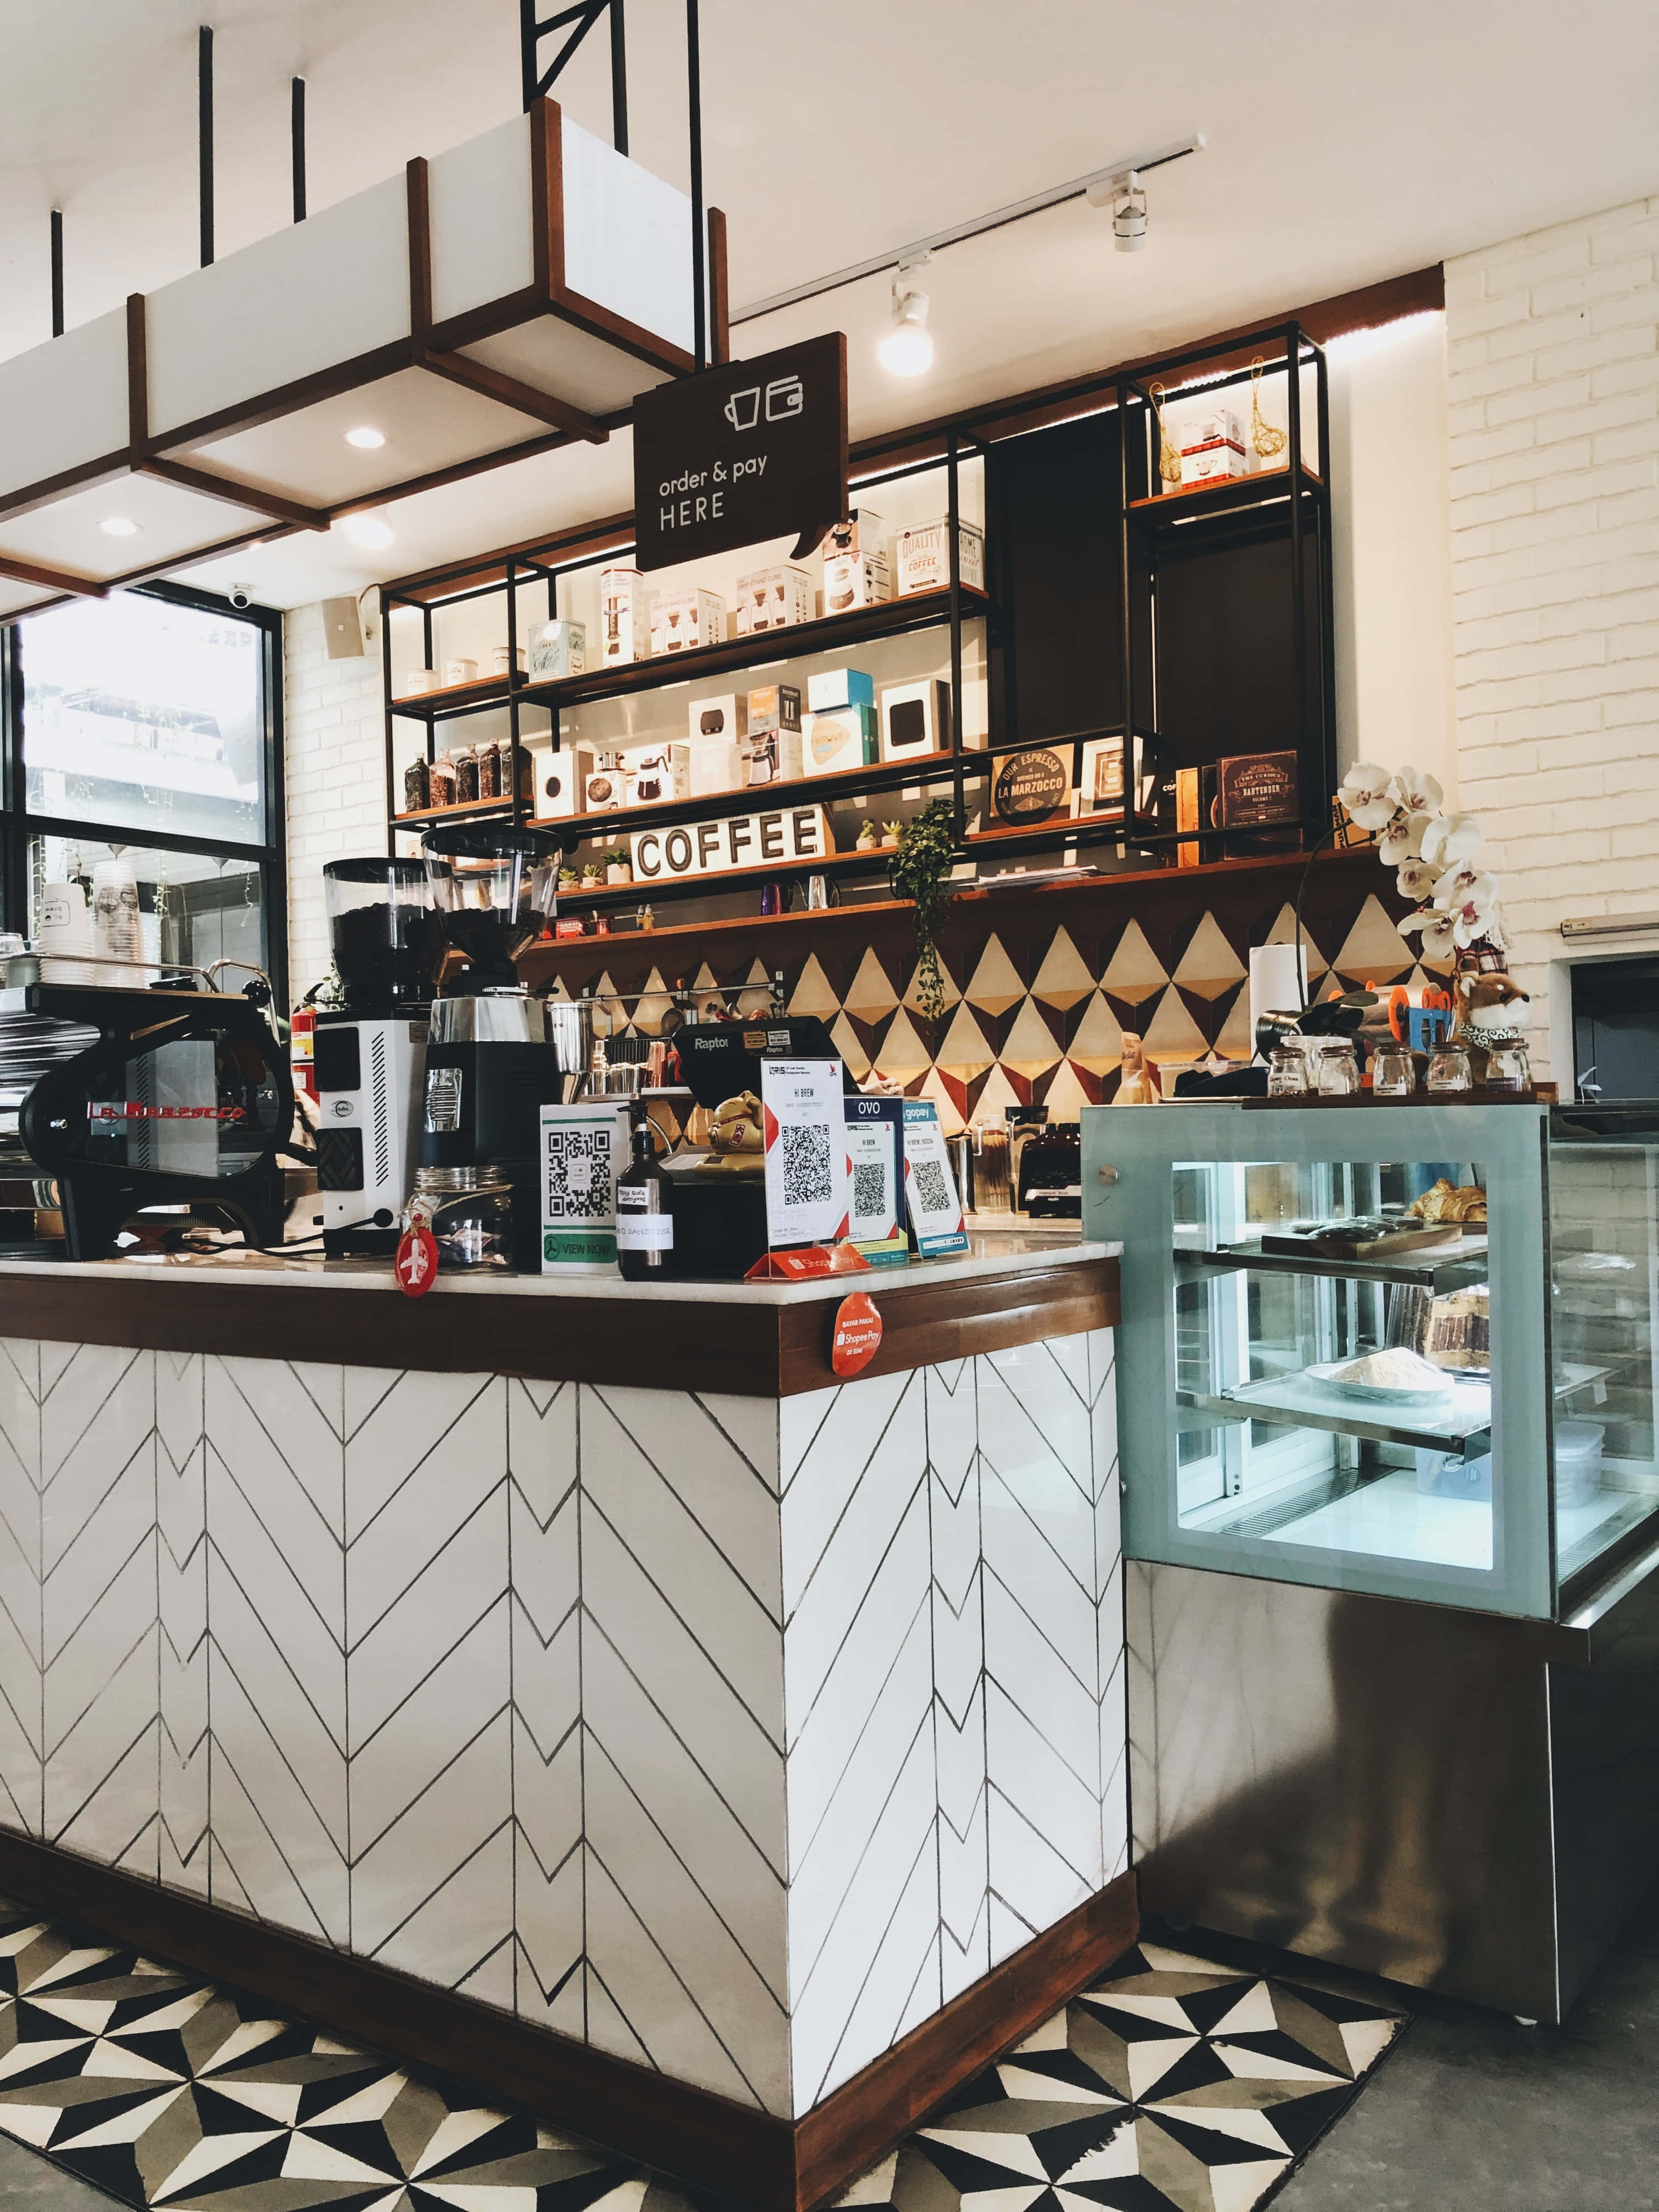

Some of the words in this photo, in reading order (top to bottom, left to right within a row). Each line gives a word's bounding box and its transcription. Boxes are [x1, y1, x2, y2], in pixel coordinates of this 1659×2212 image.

[659, 470, 708, 496] order
[713, 461, 727, 482] &
[733, 455, 768, 483] pay
[660, 492, 724, 532] HERE
[902, 531, 941, 559] QUALITY
[908, 557, 937, 571] COFFEE
[1002, 763, 1019, 781] OUR
[1020, 752, 1060, 773] ESPRESSO
[998, 787, 1008, 799] LA
[1011, 777, 1063, 797] MARZOCCO
[1243, 785, 1280, 796] BARTENDER
[1332, 804, 1346, 849] PULMAN
[637, 809, 817, 877] COFFEE
[794, 1088, 799, 1097] HI
[800, 1088, 814, 1097] BREW
[858, 1102, 881, 1114] OVO
[905, 1108, 929, 1120] gopay
[562, 1244, 586, 1255] VIEW
[587, 1243, 611, 1255] NOW
[842, 1319, 859, 1328] BAYAR
[859, 1317, 874, 1326] PAKAI
[845, 1329, 880, 1345] ShopeePay
